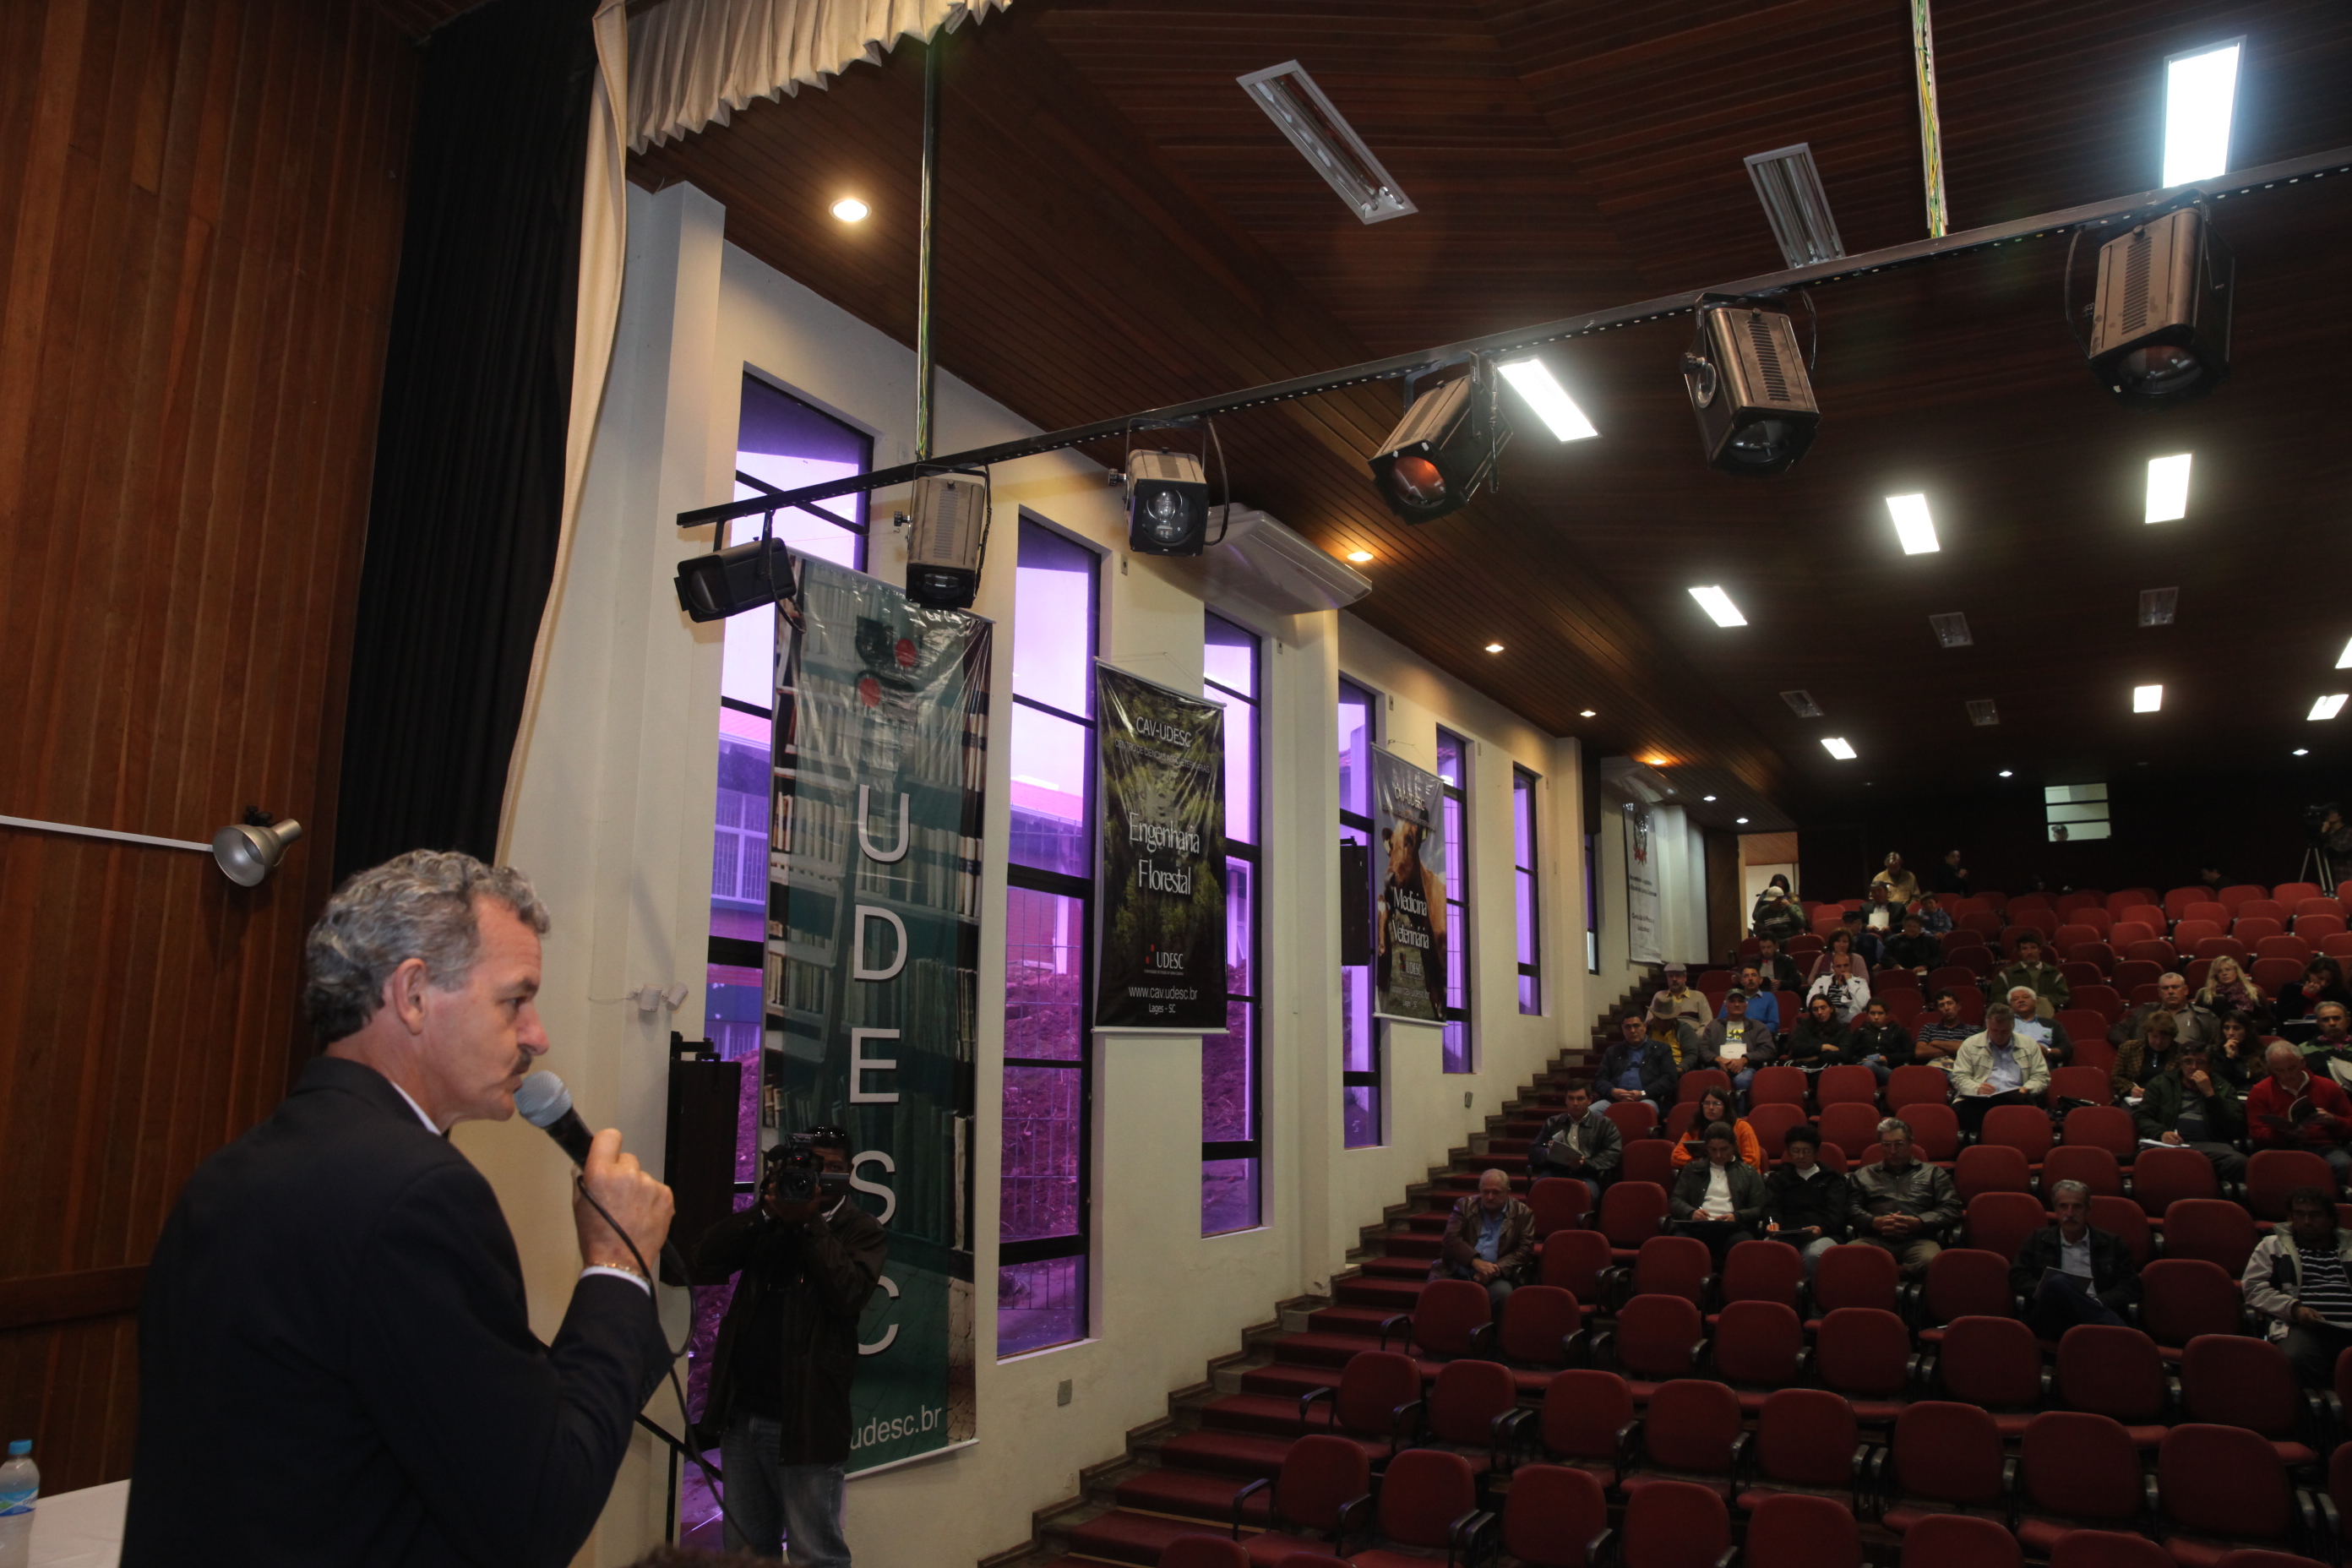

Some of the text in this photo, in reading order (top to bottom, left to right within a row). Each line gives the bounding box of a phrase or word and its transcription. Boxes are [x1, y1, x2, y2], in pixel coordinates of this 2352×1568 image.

[1114, 738, 1136, 752] CENTRO
[1137, 744, 1144, 754] DE
[1135, 716, 1192, 748] CAV-UDESC
[1129, 811, 1200, 854] Engenharia
[1138, 858, 1191, 896] Florestal
[1393, 885, 1427, 917] Medicina
[1391, 919, 1429, 950] Veterinária
[1156, 951, 1184, 970] UDESC
[1128, 985, 1198, 1000] www.cav.udesc.br
[1148, 1003, 1164, 1015] Lages
[1168, 1003, 1176, 1014] SC
